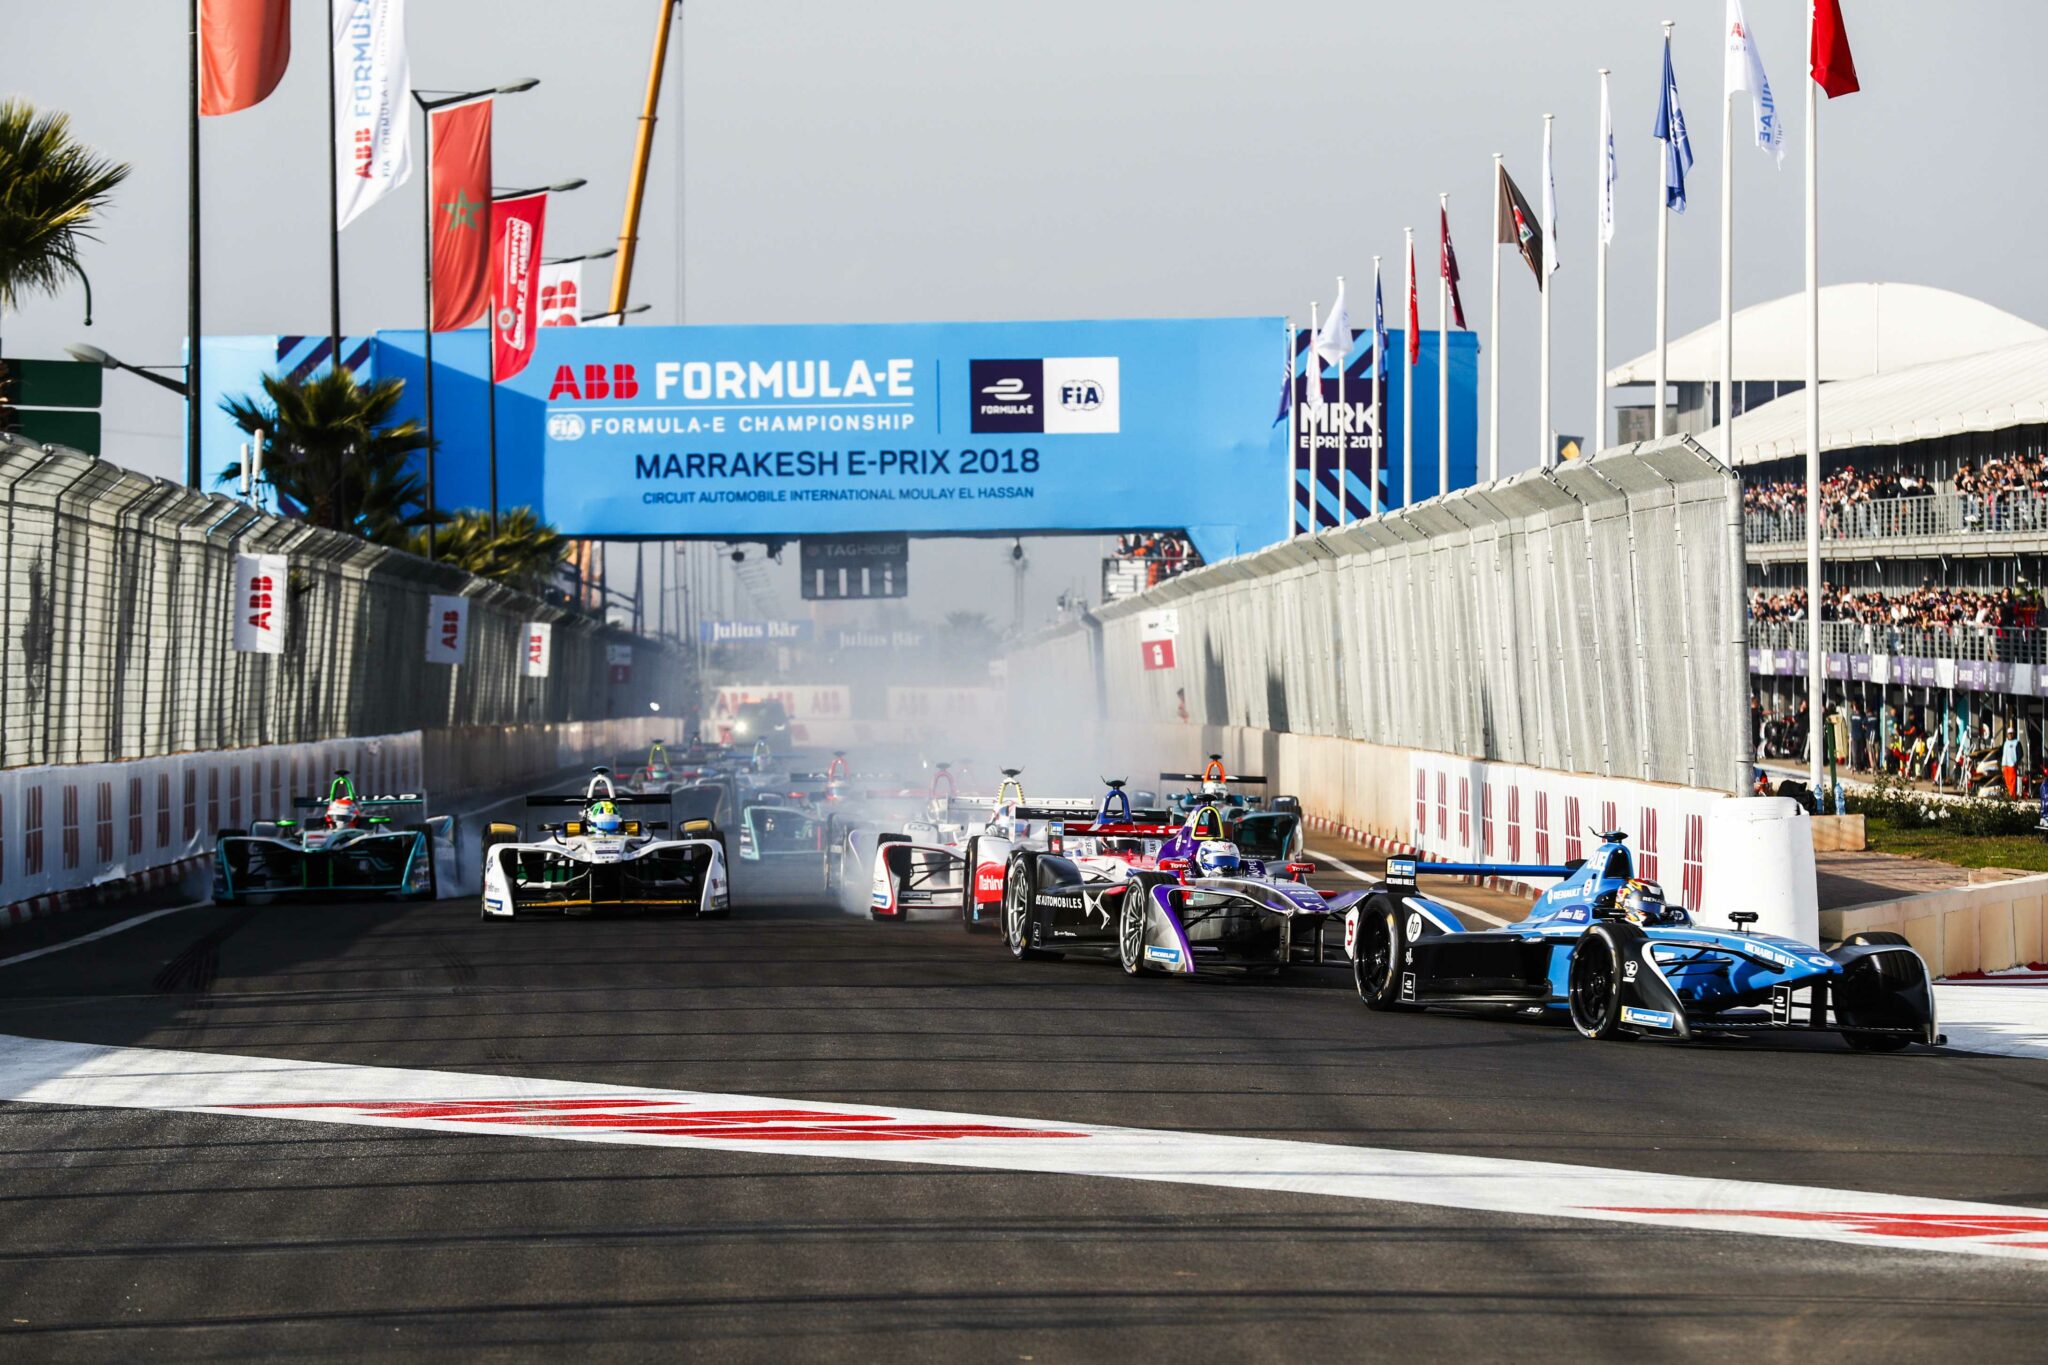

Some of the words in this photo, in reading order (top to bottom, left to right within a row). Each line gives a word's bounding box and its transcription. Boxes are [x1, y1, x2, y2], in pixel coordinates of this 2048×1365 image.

[354, 127, 373, 179] ABB
[548, 364, 640, 401] ABB
[656, 359, 915, 400] FORMULA-E
[981, 405, 1034, 415] FORMULA-E
[1300, 402, 1382, 433] MRK
[591, 416, 726, 435] FORMULA-E
[738, 413, 915, 433] CHAMPIONSHIP
[1300, 436, 1348, 448] EPRI
[635, 450, 839, 480] MARRAKESH
[847, 449, 952, 477] E-PRIX
[959, 448, 1040, 475] 2018
[642, 491, 696, 505] CIRCUIT
[699, 490, 787, 504] AUTOMOBILE
[790, 488, 896, 502] INTERNATIONAL
[899, 488, 957, 501] MOULAY
[958, 488, 975, 500] EL
[978, 487, 1034, 500] HASSAN
[249, 576, 272, 631] ABB
[441, 611, 460, 649] ABB
[713, 621, 763, 641] Julius
[768, 620, 800, 638] Bär
[529, 635, 543, 664] ABB
[1681, 813, 1704, 913] ABB
[979, 874, 1003, 891] Mahin
[1041, 895, 1083, 909] AUTOMOBILES
[1775, 952, 1797, 968] MILLE
[1632, 1012, 1669, 1024] MICHELIN
